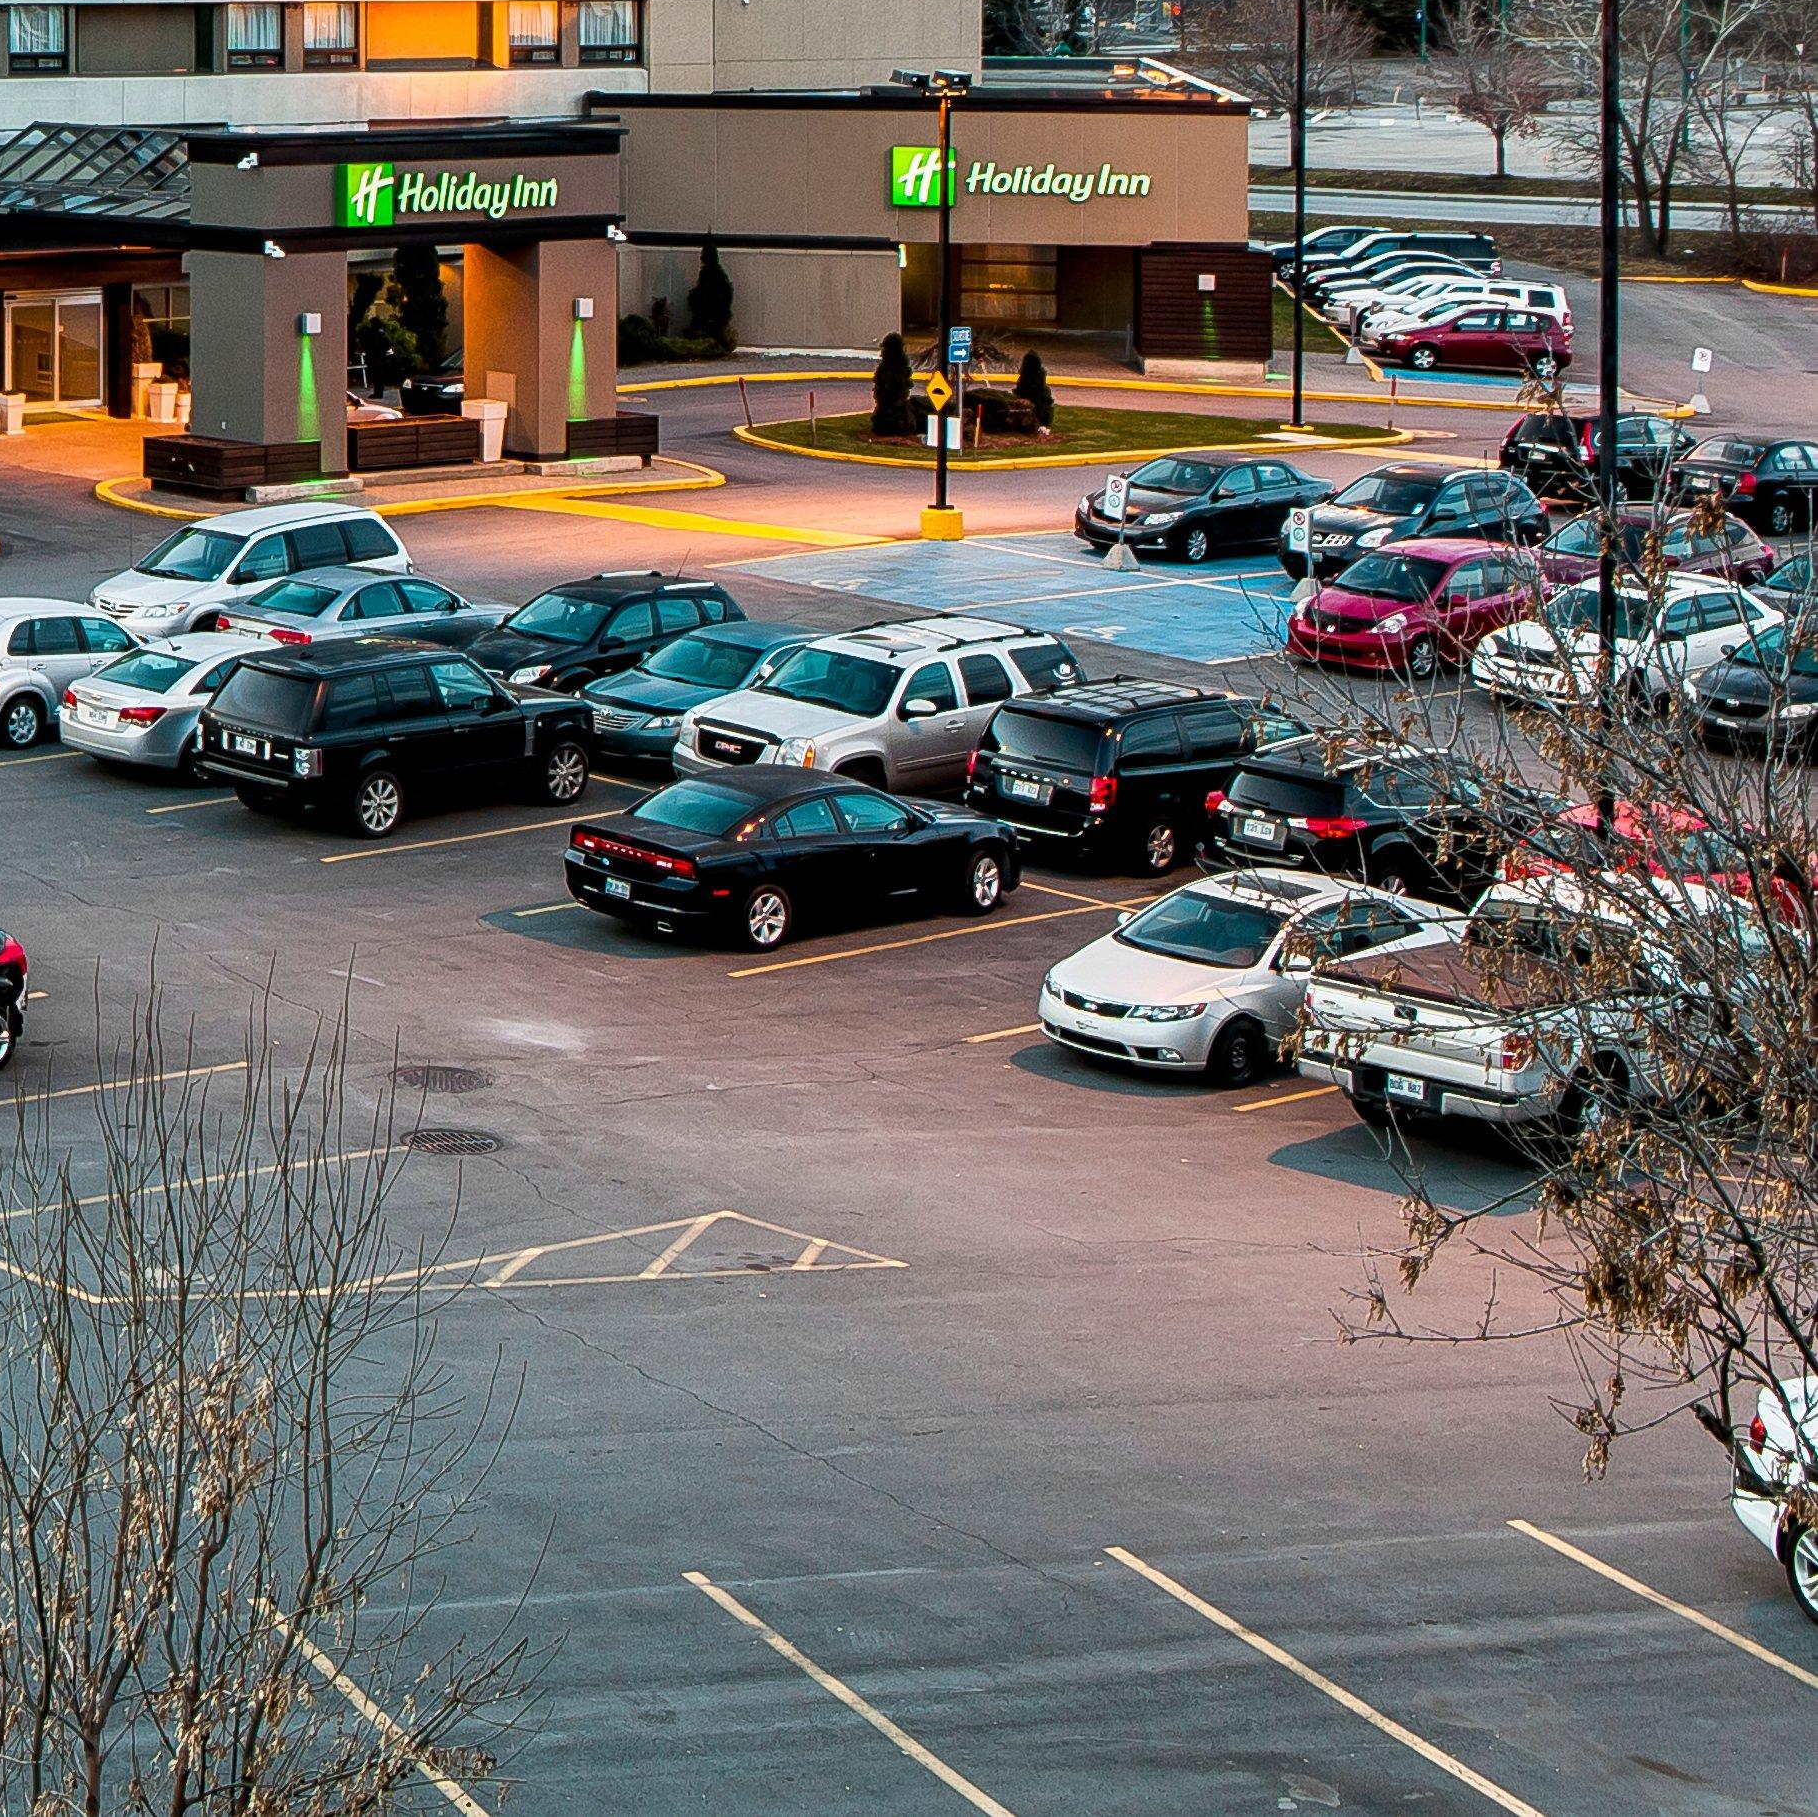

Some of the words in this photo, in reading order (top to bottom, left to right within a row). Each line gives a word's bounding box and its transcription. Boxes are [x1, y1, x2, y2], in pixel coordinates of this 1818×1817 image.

[398, 172, 510, 219] Holiday
[513, 174, 557, 208] Inn
[966, 161, 1095, 202] Holiday
[1096, 163, 1152, 196] Inn
